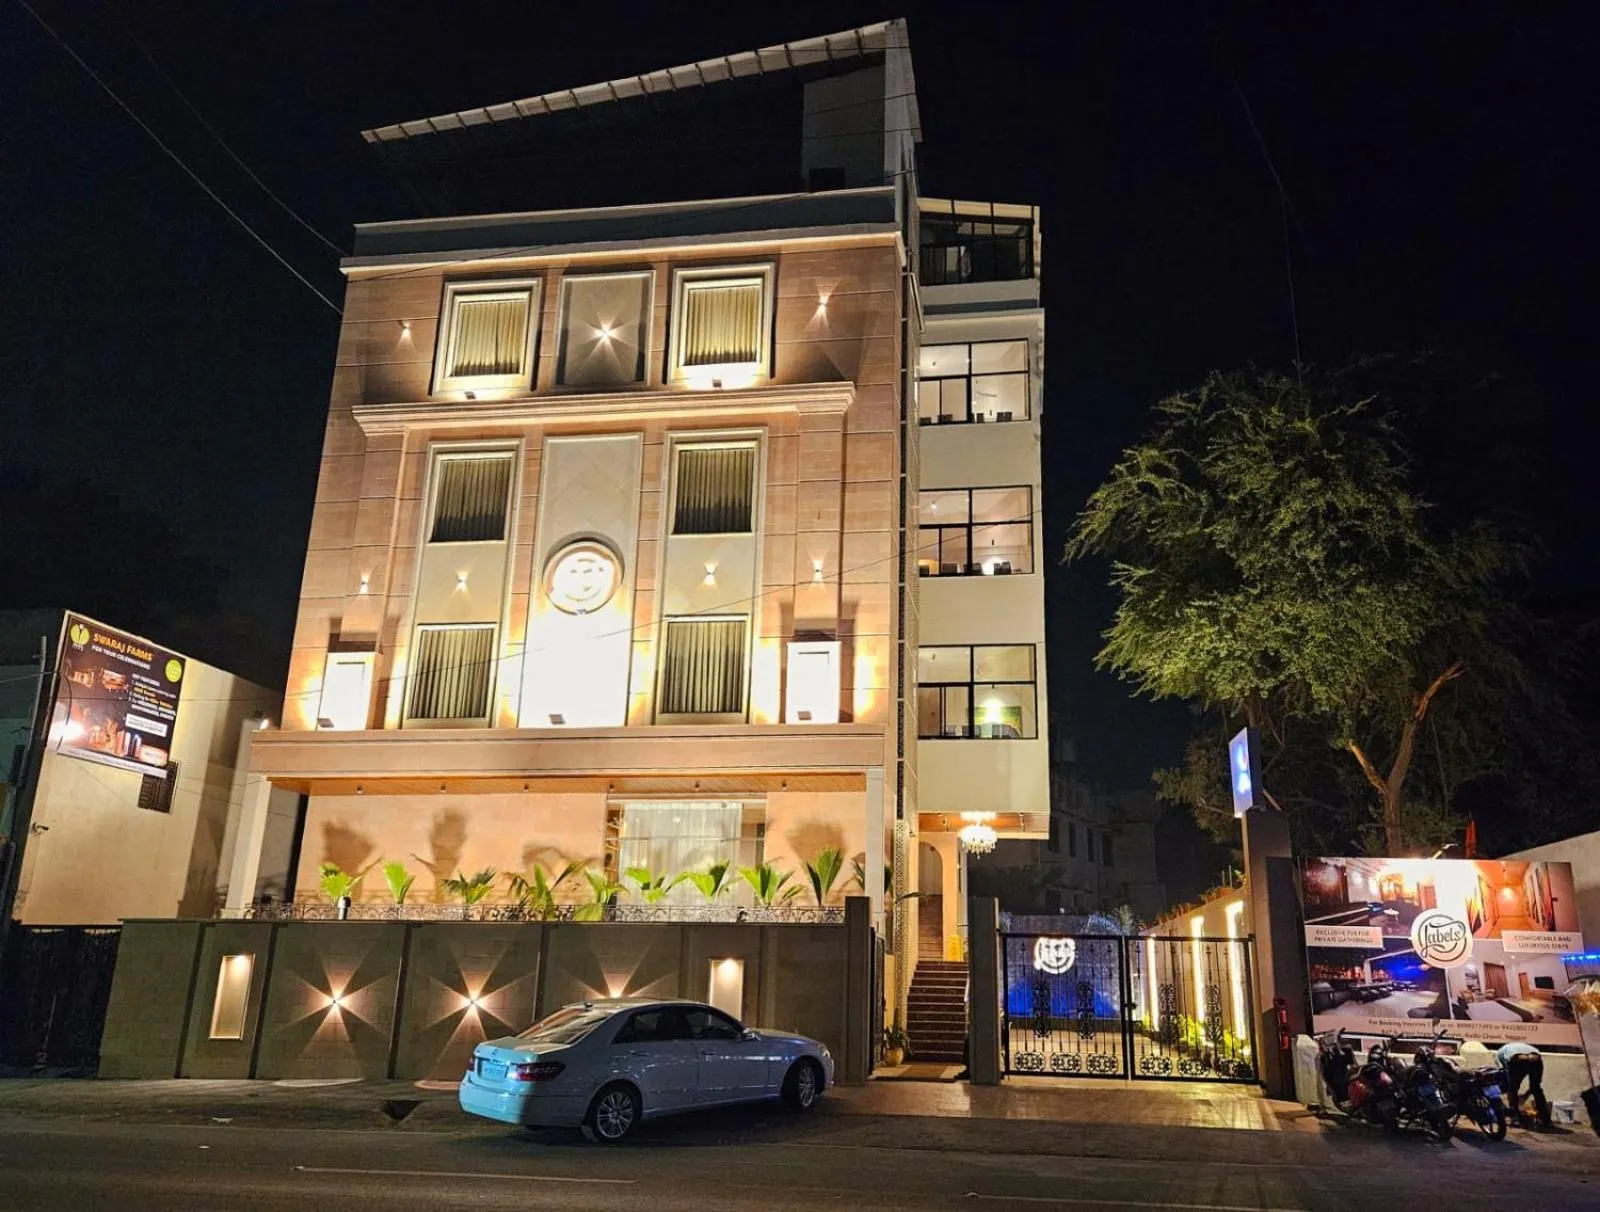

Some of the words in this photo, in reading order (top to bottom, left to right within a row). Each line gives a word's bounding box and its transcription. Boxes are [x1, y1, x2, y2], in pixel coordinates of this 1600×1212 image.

[93, 633, 125, 653] SWARAJ
[126, 643, 154, 661] FARMS
[1337, 936, 1374, 944] GATHERINGS
